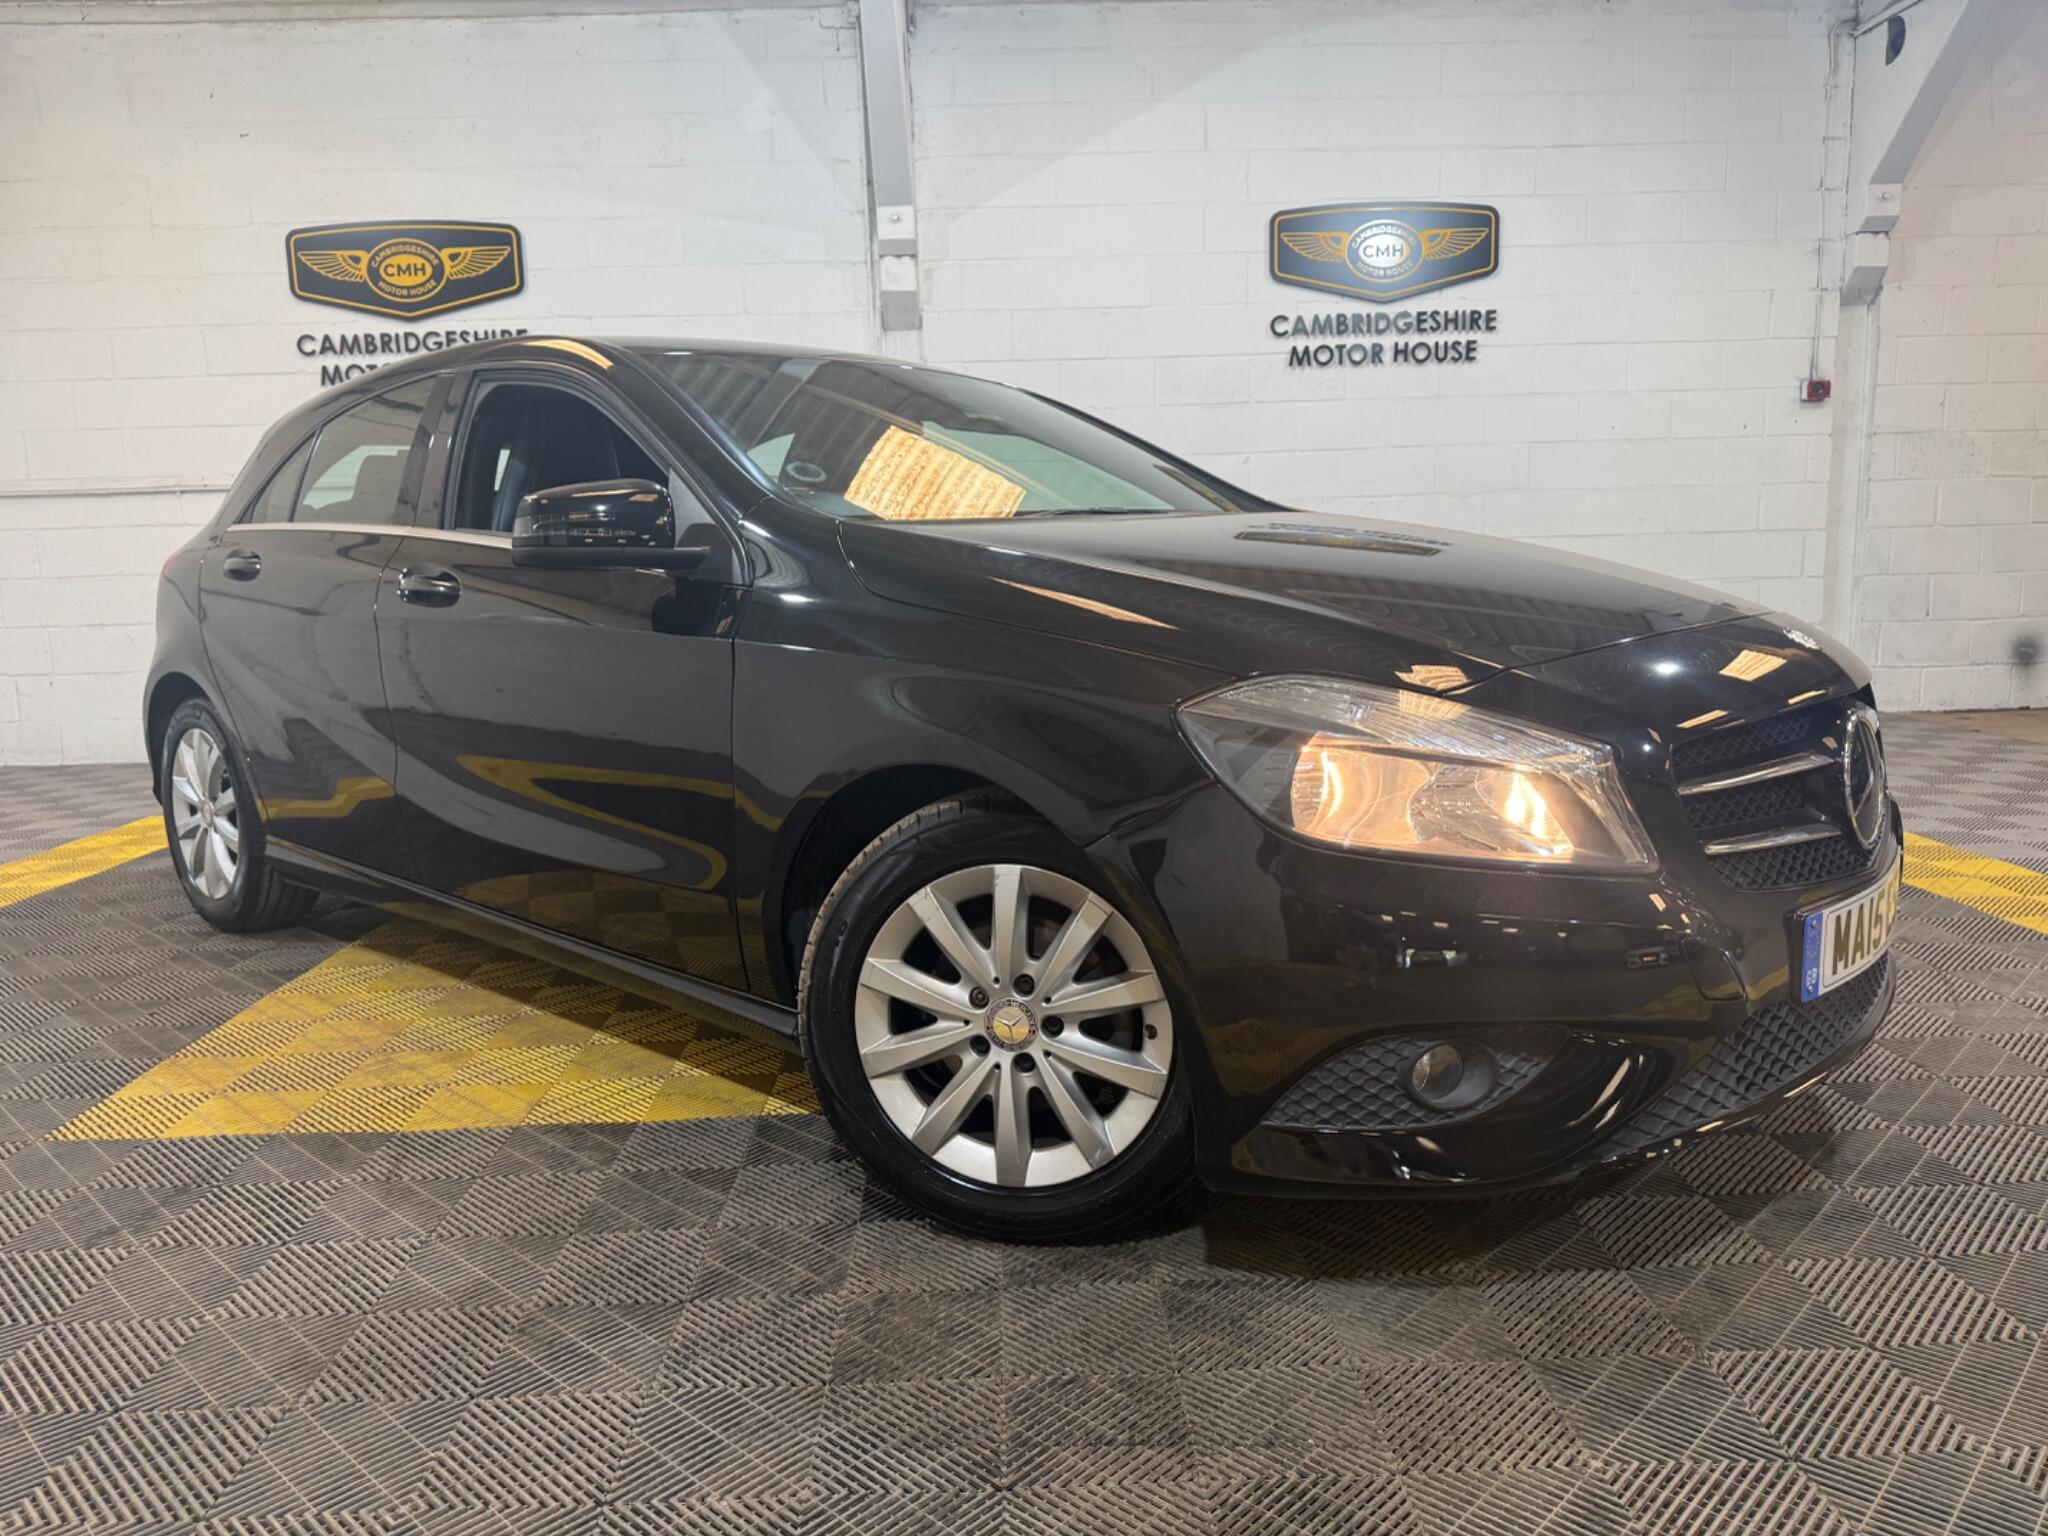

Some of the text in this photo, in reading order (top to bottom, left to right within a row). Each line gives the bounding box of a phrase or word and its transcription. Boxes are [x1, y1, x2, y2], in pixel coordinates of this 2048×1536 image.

[1363, 244, 1405, 258] CMH
[383, 262, 427, 277] CMH
[1270, 309, 1498, 338] CAMBRIDGESHIRE
[1288, 340, 1478, 367] MOTOR HOUSE
